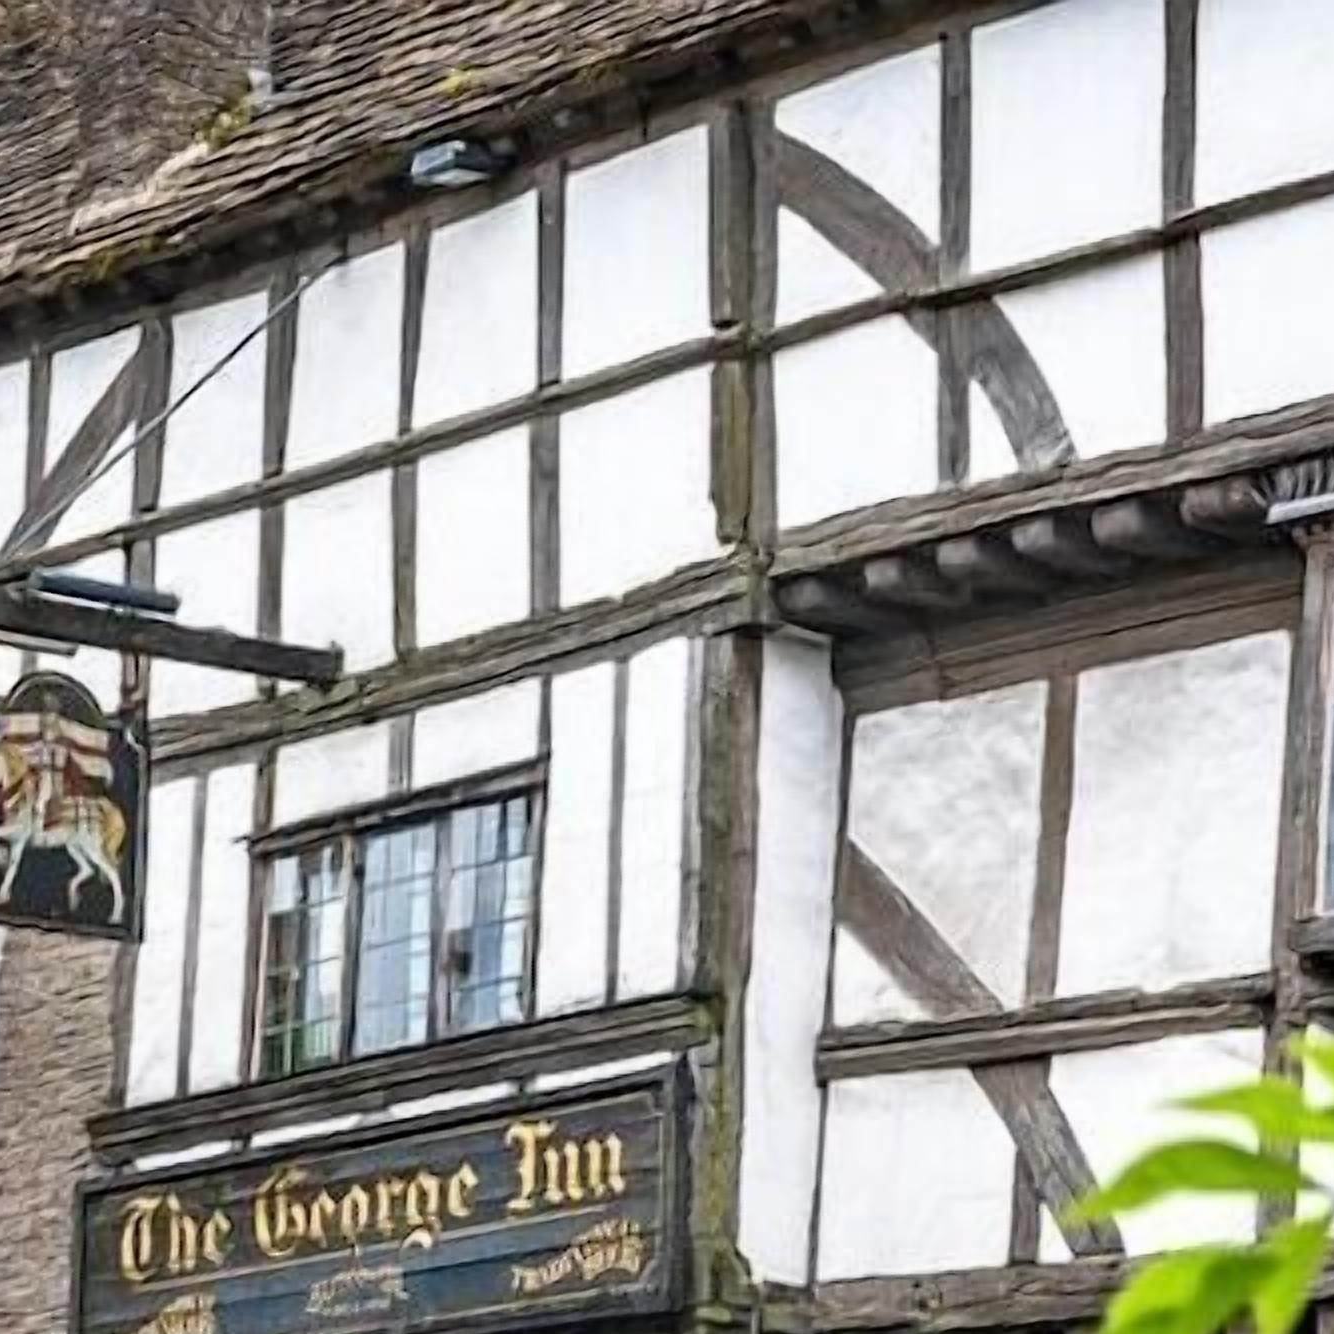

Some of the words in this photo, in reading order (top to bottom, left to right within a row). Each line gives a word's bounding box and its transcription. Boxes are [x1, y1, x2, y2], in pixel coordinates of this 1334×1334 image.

[120, 1191, 233, 1282] The
[253, 1164, 479, 1256] George
[506, 1120, 627, 1211] Inn
